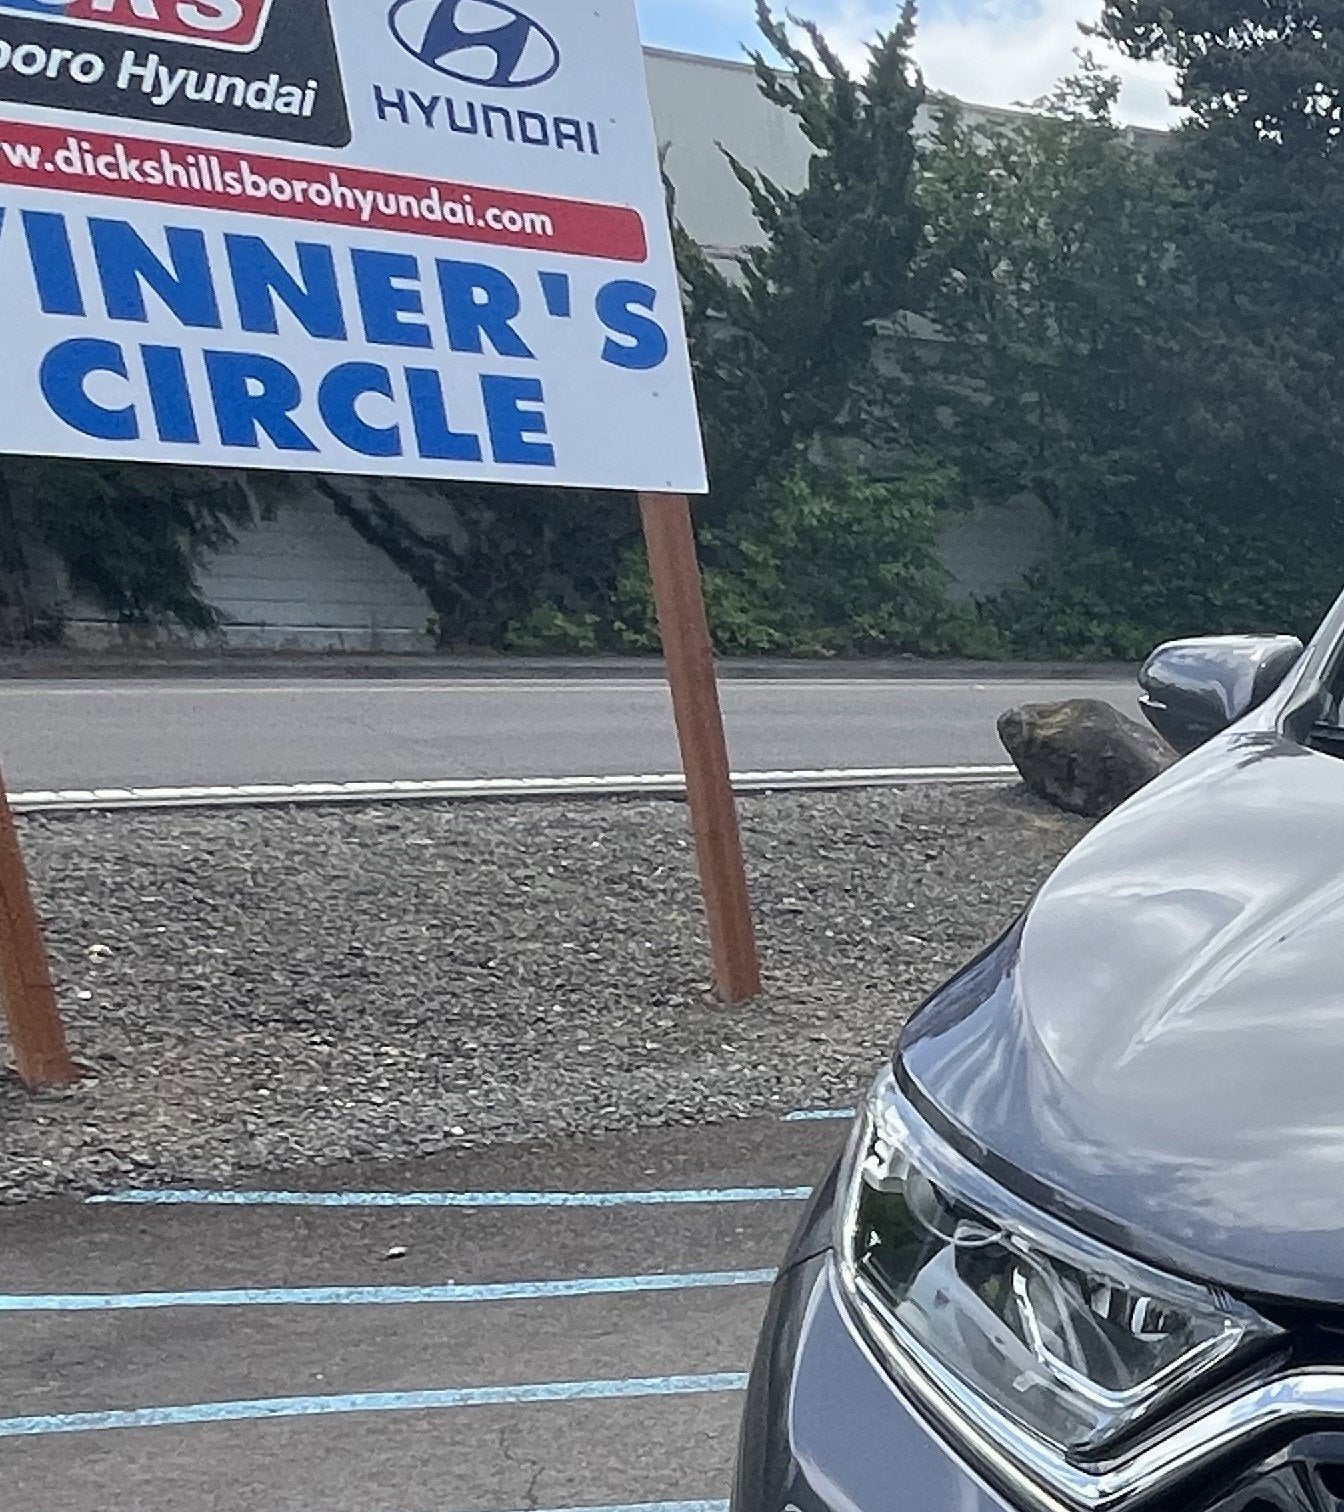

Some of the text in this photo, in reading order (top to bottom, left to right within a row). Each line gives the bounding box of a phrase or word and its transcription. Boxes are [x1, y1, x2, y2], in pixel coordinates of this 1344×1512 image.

[117, 50, 318, 117] Hyundai
[373, 84, 600, 155] HYUNDAI
[0, 206, 670, 371] INNER'S
[38, 336, 557, 468] CIRCLE
